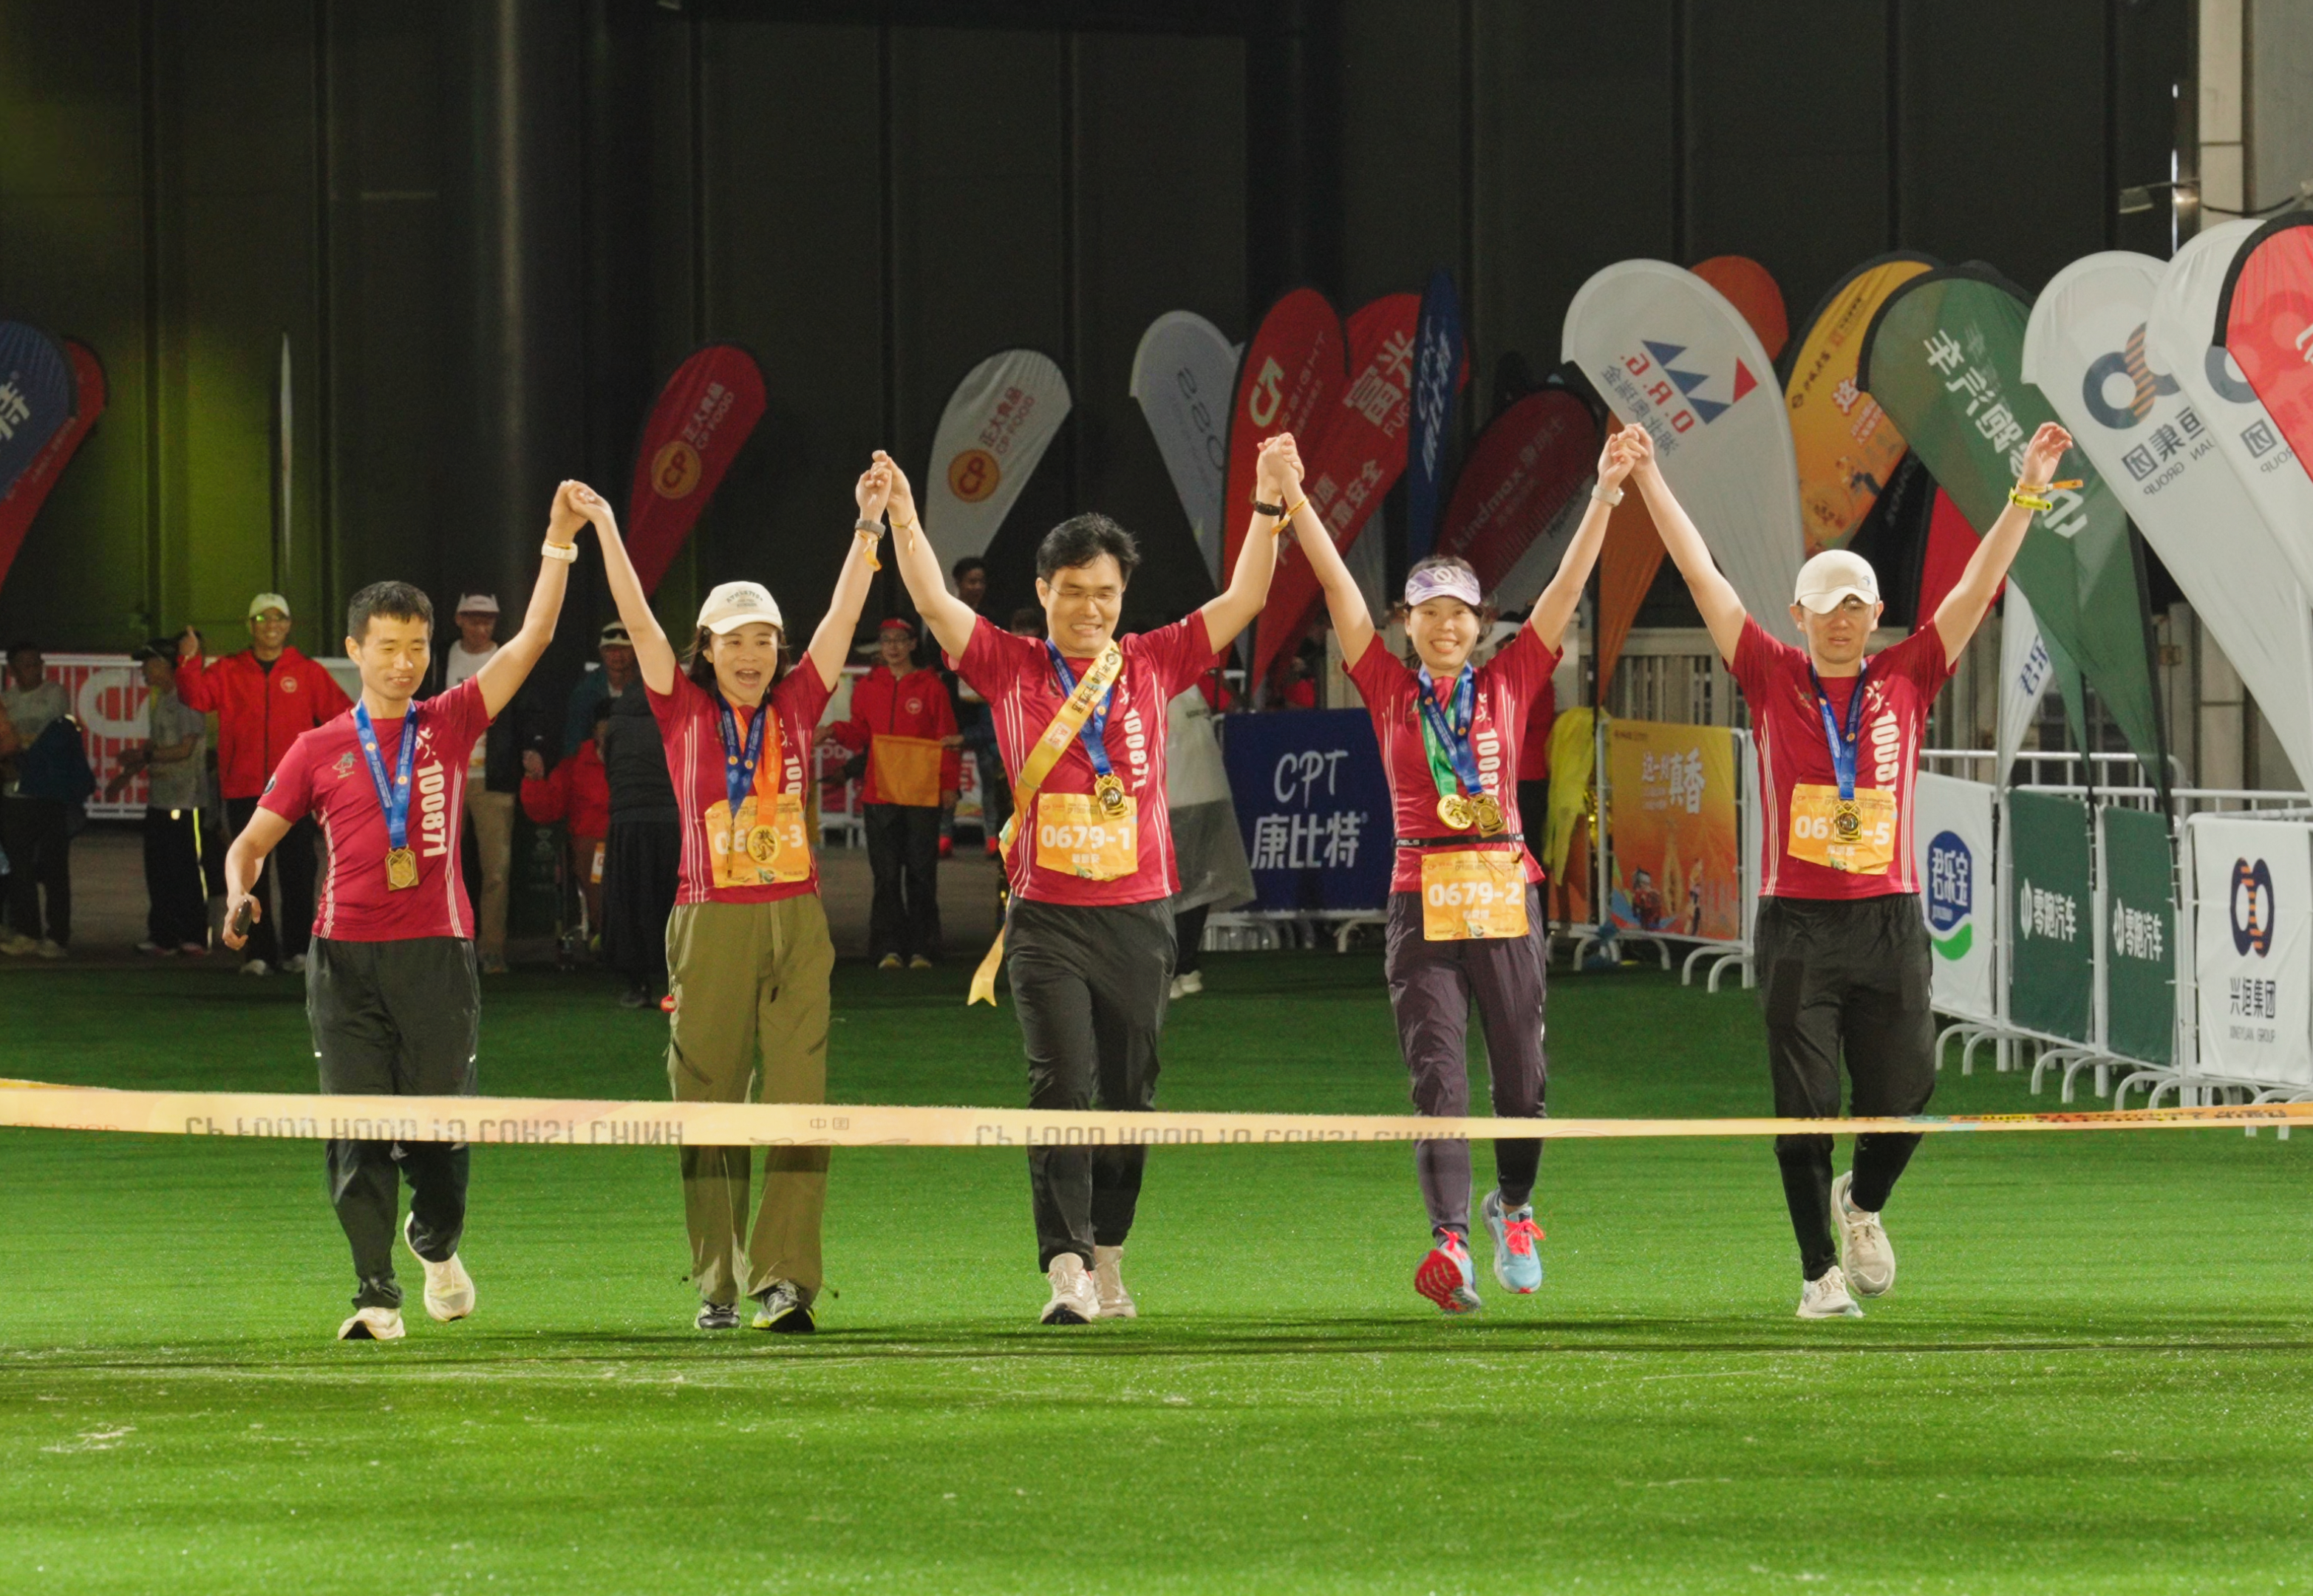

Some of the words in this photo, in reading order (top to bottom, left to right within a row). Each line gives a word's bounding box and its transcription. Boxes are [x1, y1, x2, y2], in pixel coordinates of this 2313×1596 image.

[959, 456, 986, 494] CP
[1273, 750, 1349, 809] CPT
[416, 760, 447, 858] 100871
[1794, 816, 1890, 845] 06-5
[714, 824, 803, 855] 06-3
[1040, 825, 1131, 850] 0679-1
[1250, 811, 1361, 870] 康比特
[1428, 881, 1521, 907] 0679-2
[1932, 847, 1969, 907] 君乐宝
[2033, 887, 2077, 943] 零跑汽车
[2125, 907, 2164, 962] 零跑汽车
